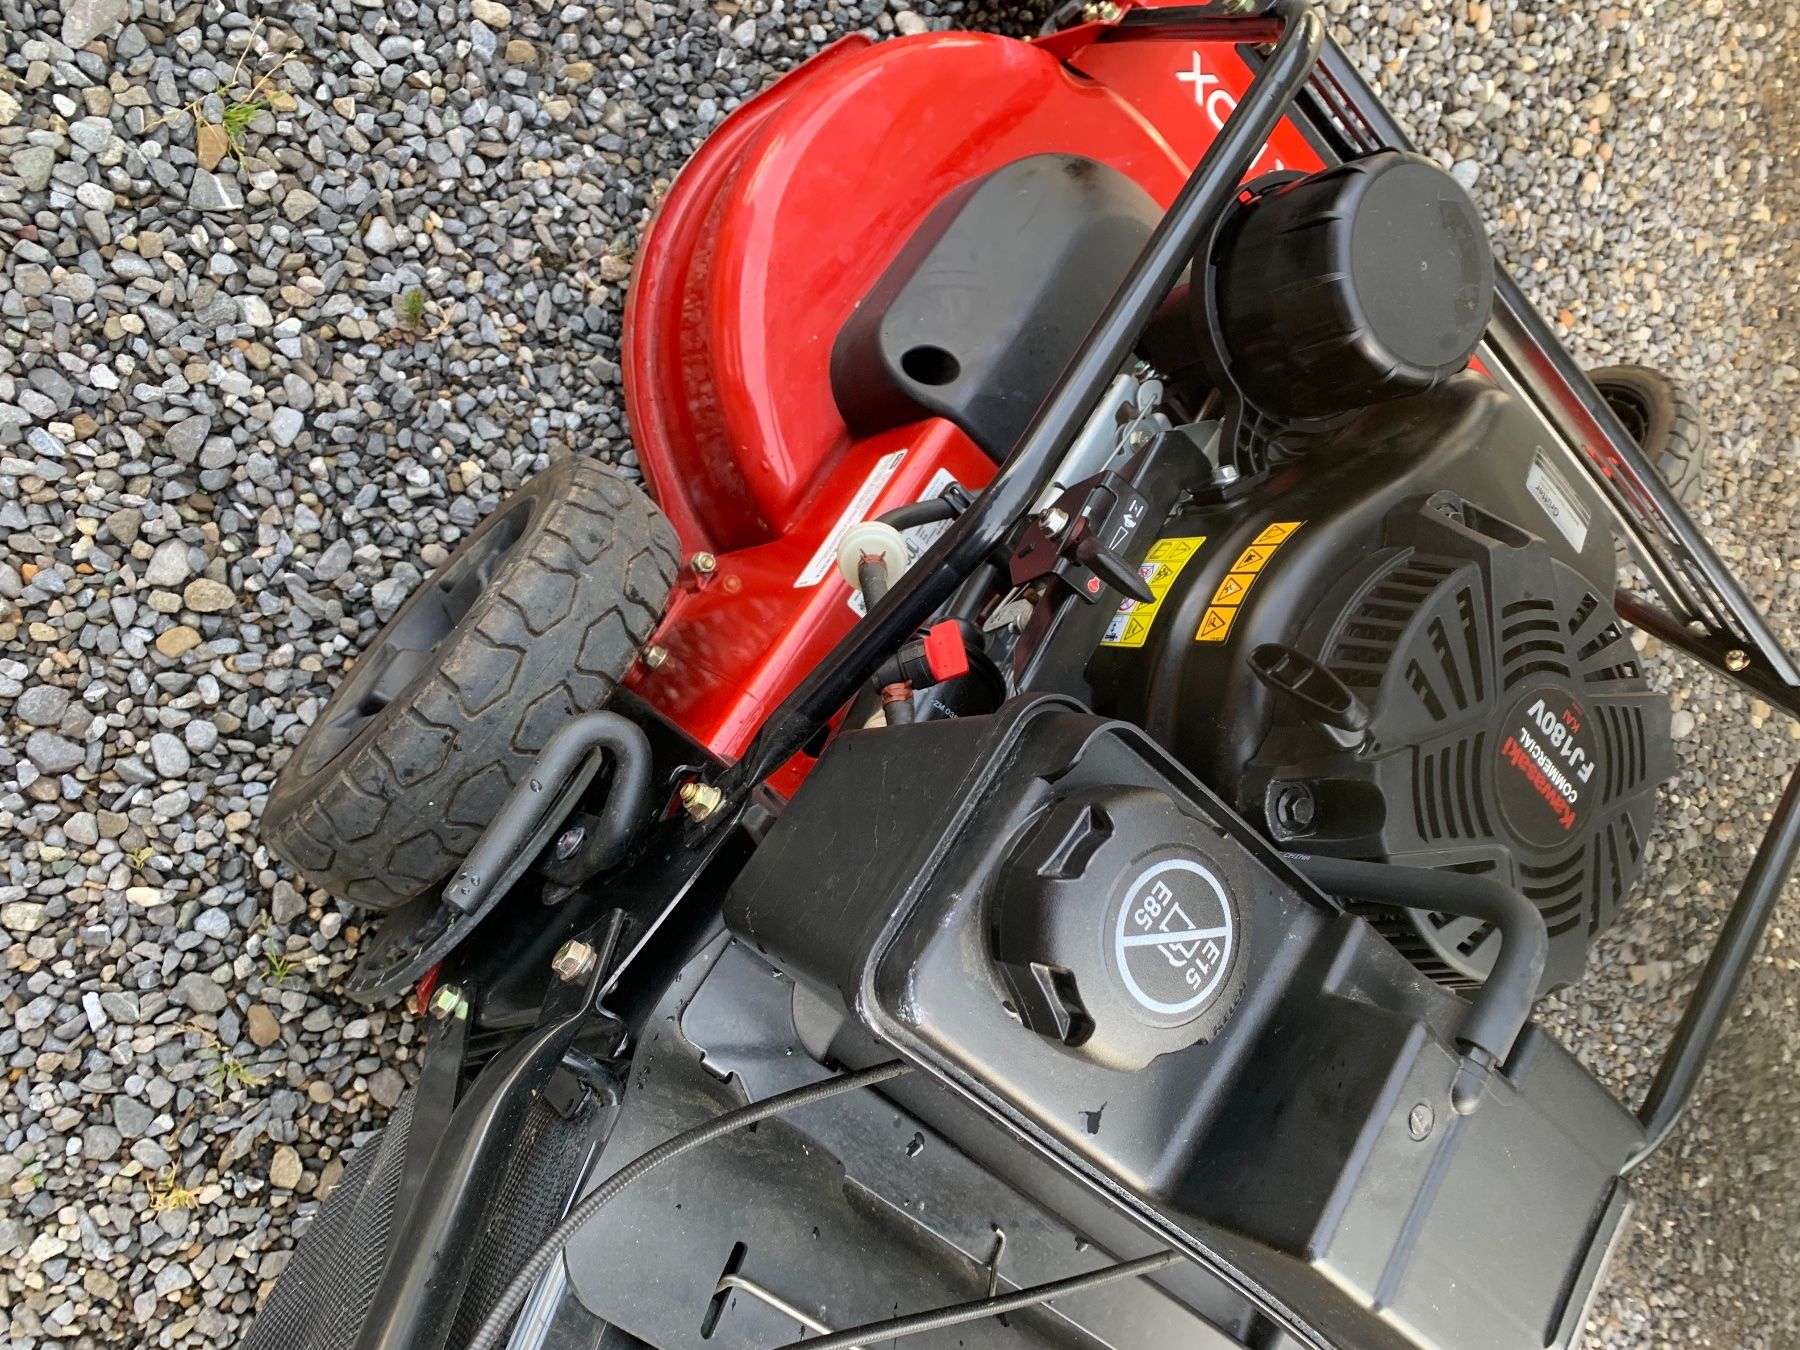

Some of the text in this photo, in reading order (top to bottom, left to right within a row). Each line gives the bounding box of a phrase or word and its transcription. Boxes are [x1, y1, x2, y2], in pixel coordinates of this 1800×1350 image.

[1518, 727, 1578, 804] COMMERCIAL
[1526, 698, 1595, 784] FJ180V
[1501, 736, 1577, 830] Kawasaki
[1134, 880, 1173, 931] E85
[1185, 940, 1220, 990] E15
